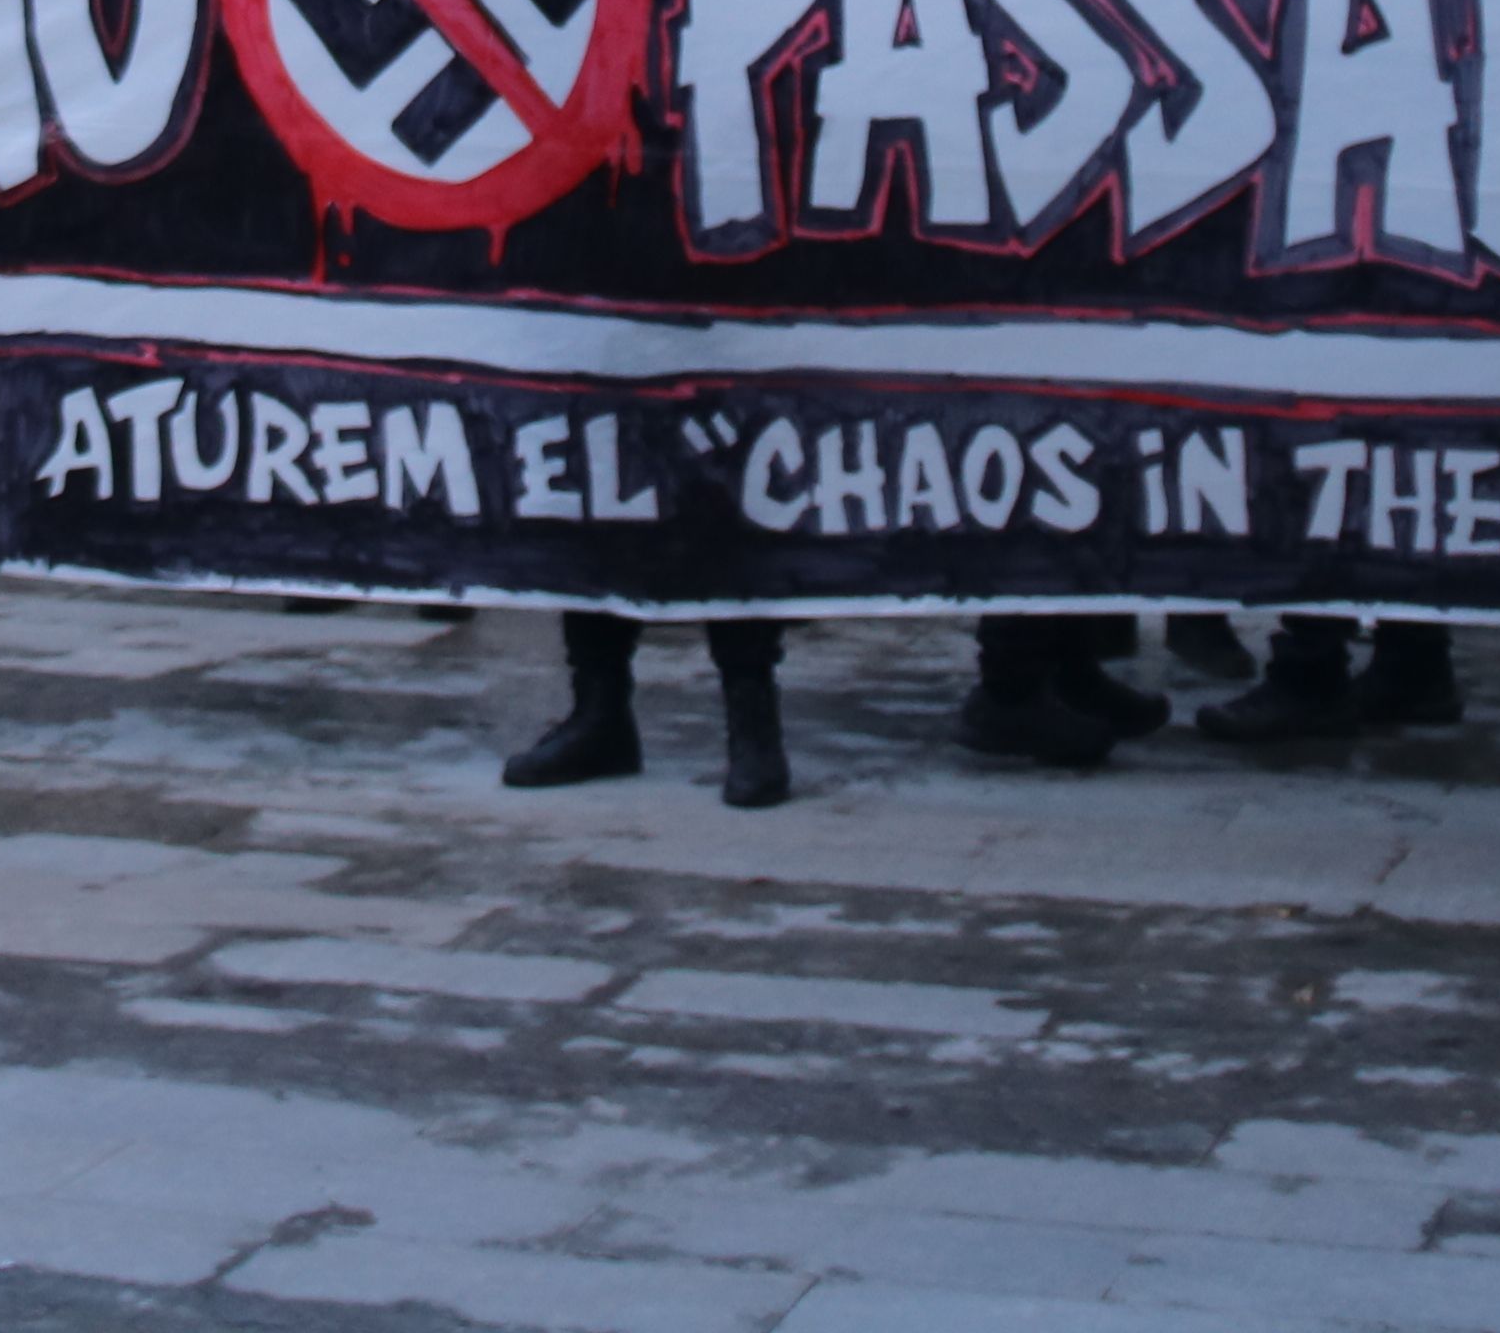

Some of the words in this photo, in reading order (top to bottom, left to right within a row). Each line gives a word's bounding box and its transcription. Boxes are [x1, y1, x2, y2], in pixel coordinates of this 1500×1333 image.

[34, 378, 481, 517] ATUREM
[515, 414, 659, 520] EL
[681, 411, 1101, 534] "CHAOS
